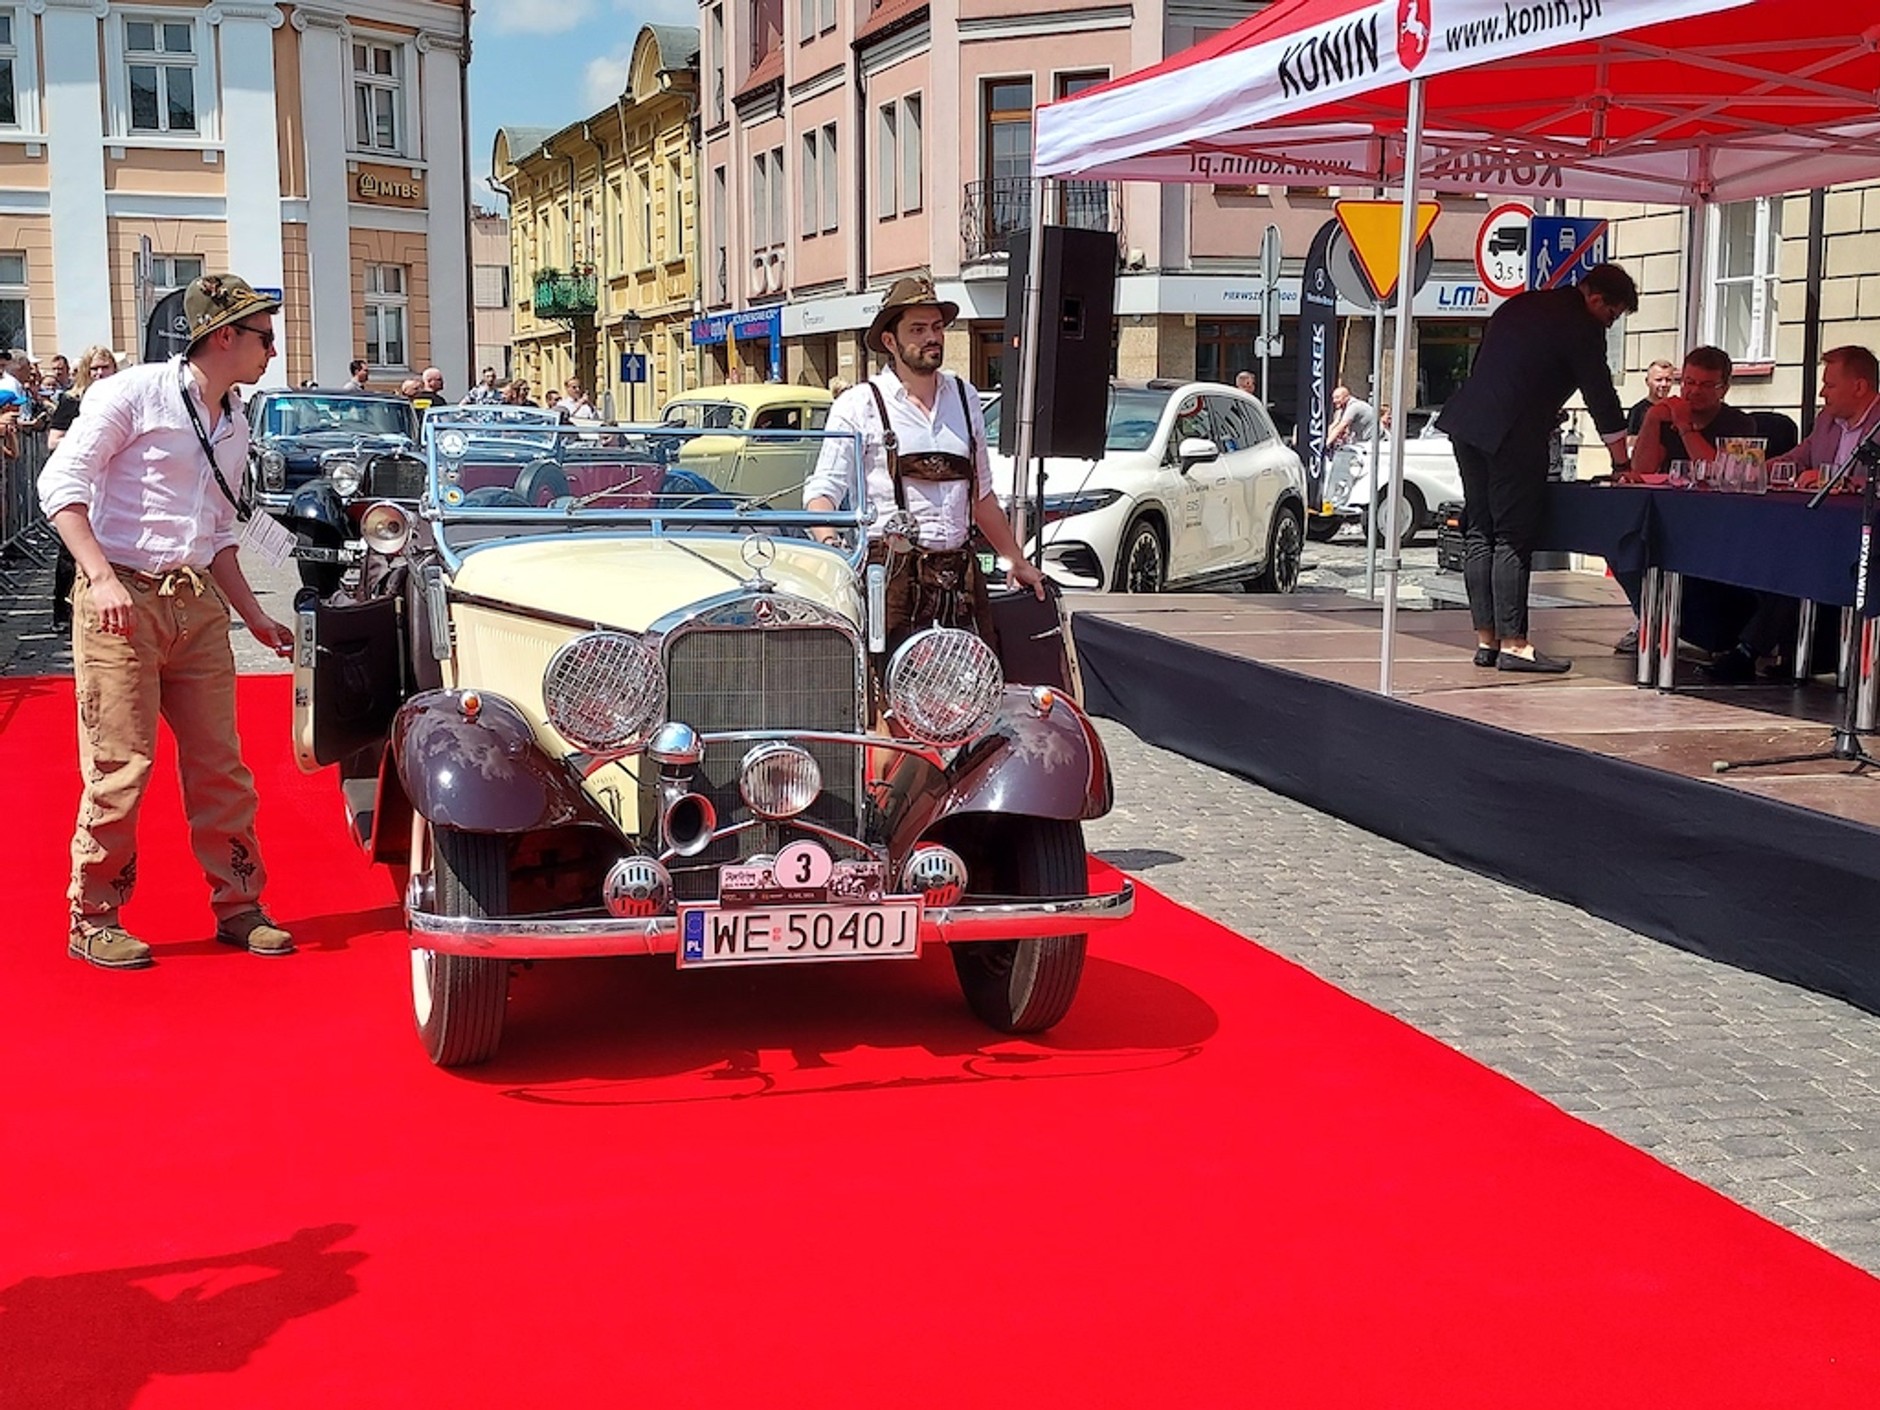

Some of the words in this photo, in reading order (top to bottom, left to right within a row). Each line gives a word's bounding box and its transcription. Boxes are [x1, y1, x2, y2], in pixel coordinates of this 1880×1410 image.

[1278, 12, 1378, 98] KONIN
[1446, 0, 1602, 52] www.konin.pl
[380, 181, 420, 199] MTBS
[1494, 261, 1514, 281] 3,5
[1518, 265, 1524, 280] t
[1309, 322, 1326, 478] GARCAREK
[795, 853, 812, 883] 3
[686, 940, 702, 952] PL
[713, 914, 772, 955] WE
[787, 910, 907, 952] 5040J
